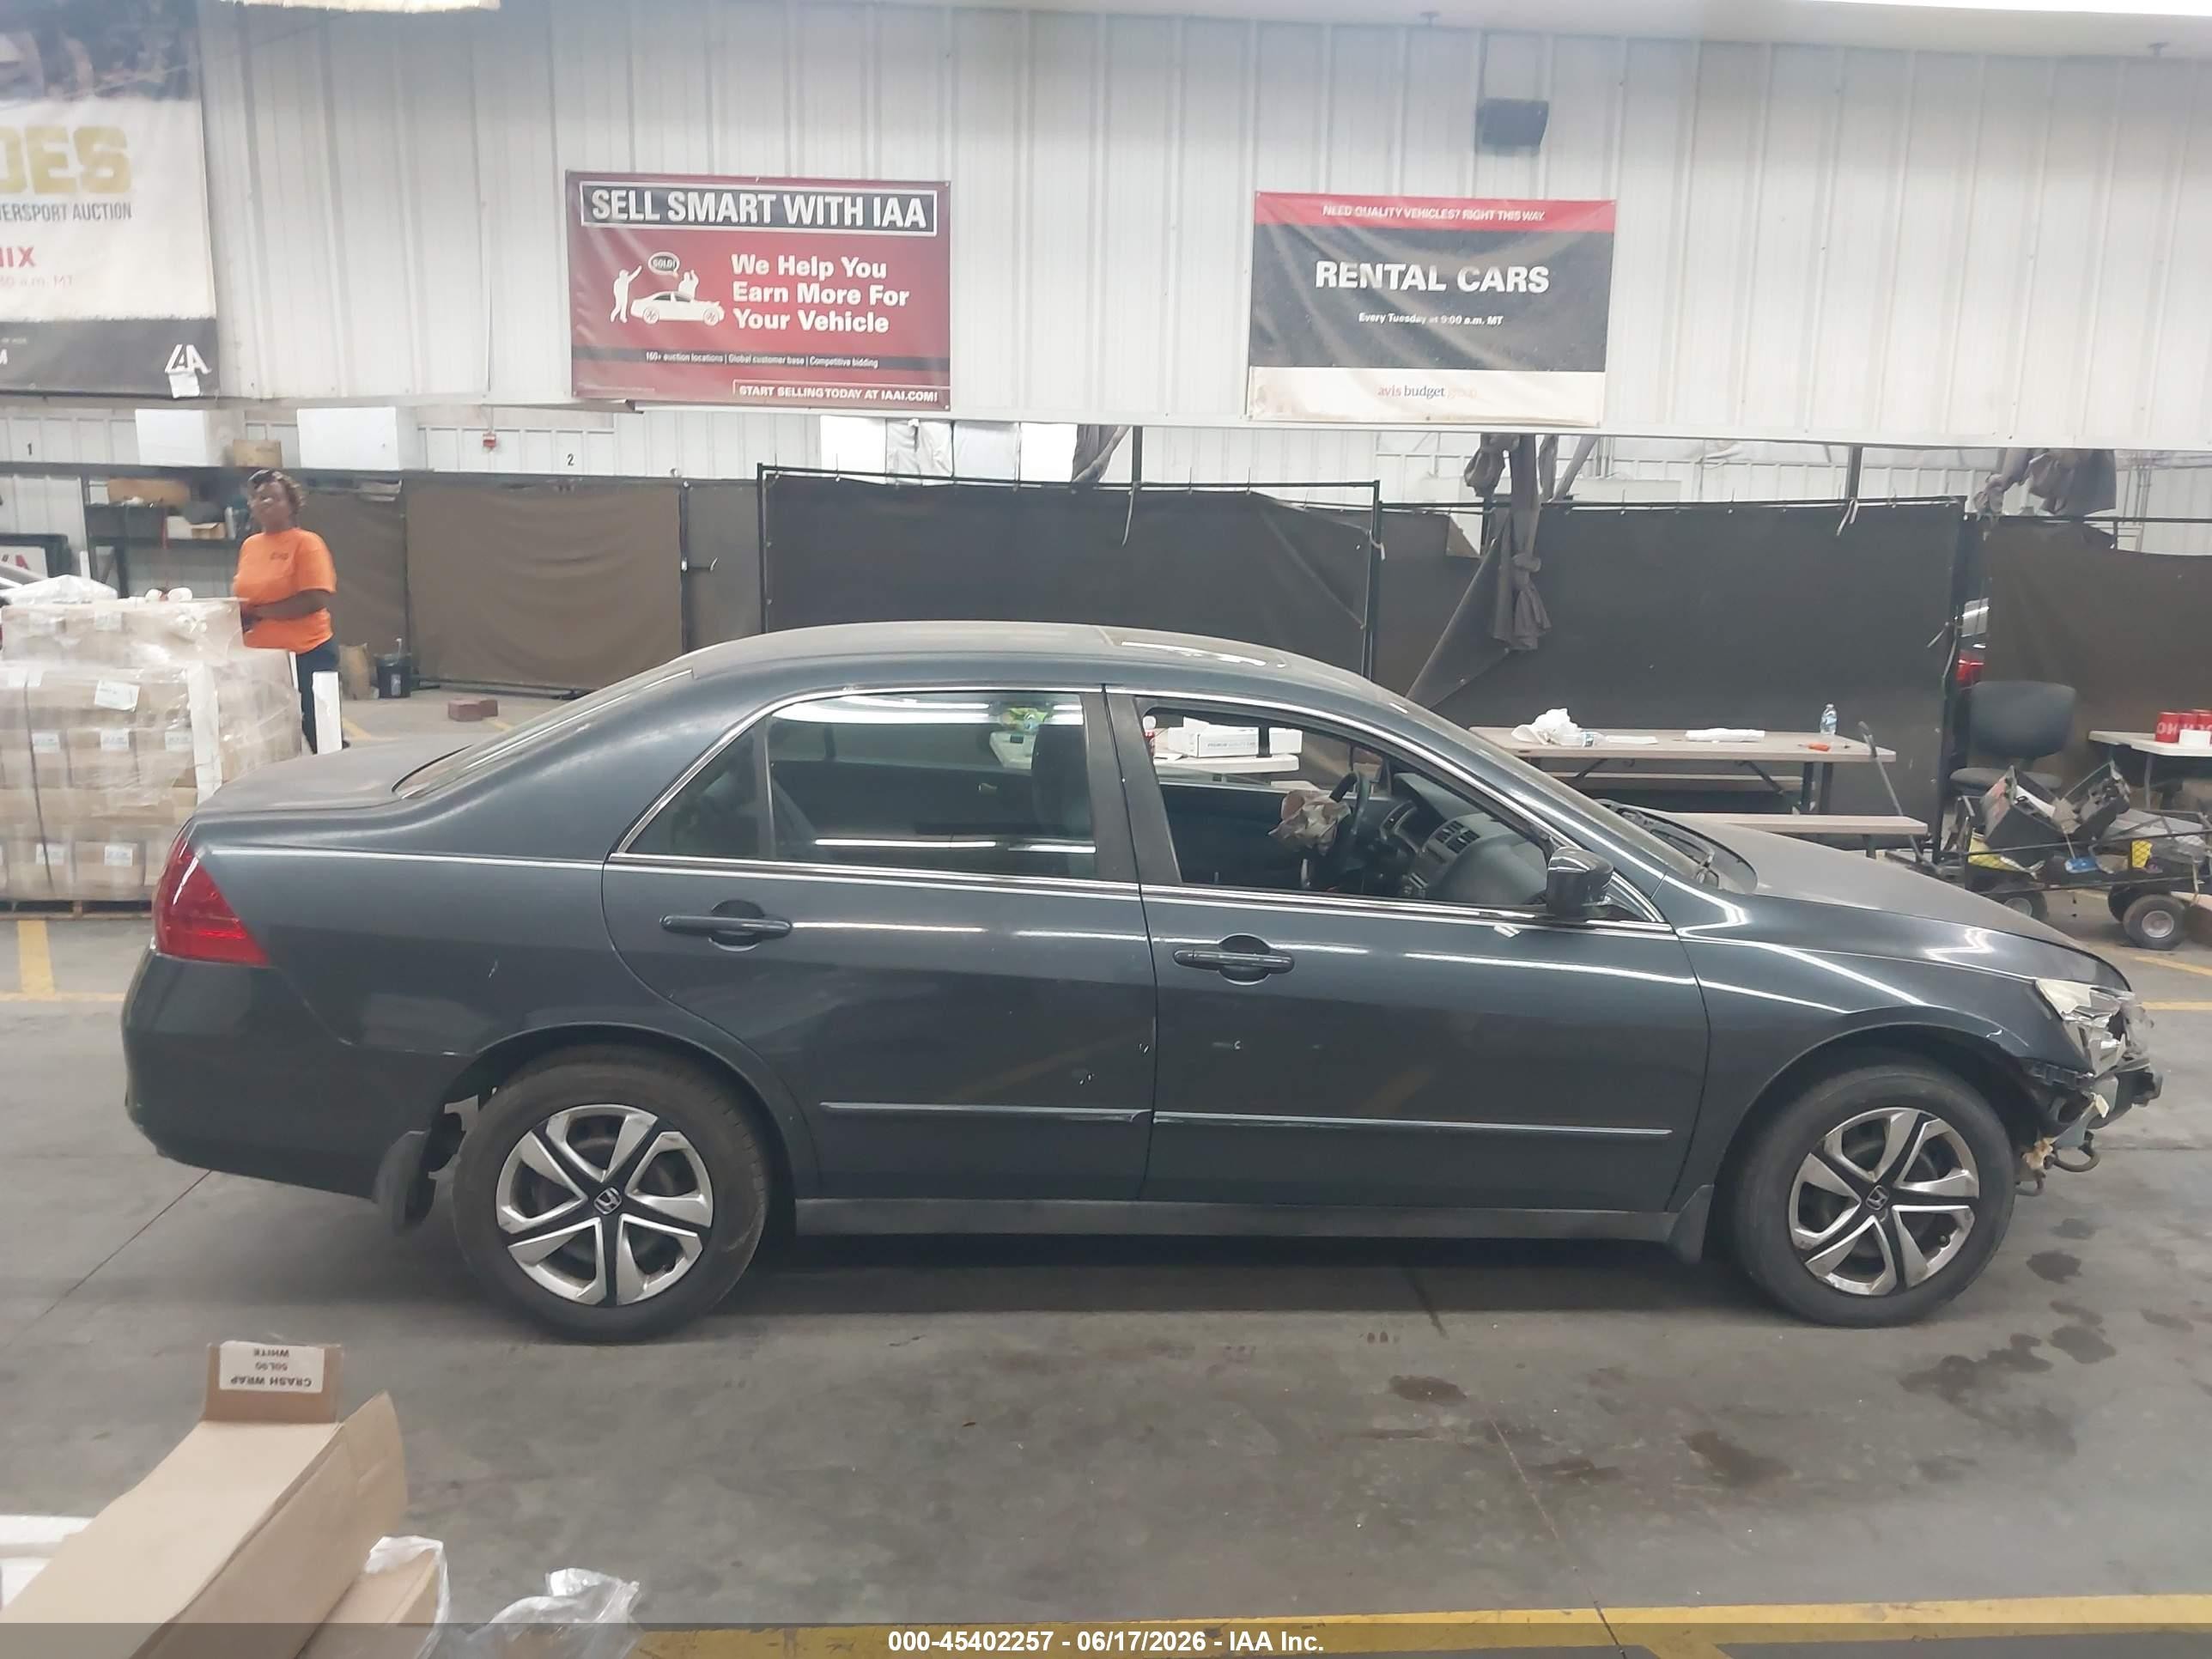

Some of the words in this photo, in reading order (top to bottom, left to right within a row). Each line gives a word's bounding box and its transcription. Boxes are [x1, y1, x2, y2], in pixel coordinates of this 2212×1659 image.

[0, 202, 67, 222] ERSPORT
[72, 201, 132, 221] AUCTION
[592, 189, 660, 222] SELL
[667, 191, 776, 224] SMART
[782, 194, 864, 228] WITH
[872, 197, 927, 229] IAA
[1322, 205, 1352, 216] NEED
[1354, 206, 1403, 218] QUALITY
[1404, 207, 1460, 220] VEHICLES?
[1462, 209, 1496, 221] RIGHT
[1497, 210, 1521, 221] THIS
[0, 246, 35, 268] IX
[731, 254, 770, 276] We
[777, 254, 835, 281] Help
[841, 256, 887, 279] You
[1315, 260, 1447, 292] RENTAL
[1457, 265, 1550, 294] CARS
[732, 281, 789, 303] Earn
[797, 283, 861, 305] More
[869, 284, 910, 307] For
[732, 308, 791, 331] Your
[797, 309, 890, 333] Vehicle
[1358, 312, 1387, 325] Every
[1388, 313, 1427, 325] Tuesday
[1440, 314, 1462, 325] 9:00
[1463, 316, 1485, 325] a.m.
[1486, 315, 1504, 326] MT
[663, 352, 690, 362] auction
[690, 353, 723, 363] locations
[728, 353, 752, 364] Global
[752, 355, 786, 364] customer
[810, 356, 851, 368] Competitive
[851, 357, 879, 369] bidding
[739, 386, 775, 397] START
[777, 386, 824, 398] SELLING
[824, 388, 863, 399] TODAY
[864, 389, 879, 400] AT
[881, 390, 938, 402] IAAI.COM!
[1376, 384, 1402, 397] avis
[1404, 384, 1445, 399] budget
[27, 442, 33, 457] 1
[567, 453, 574, 466] 2
[253, 1349, 290, 1358] WHITE
[230, 1375, 265, 1385] WRAP
[269, 1376, 313, 1388] CRASH
